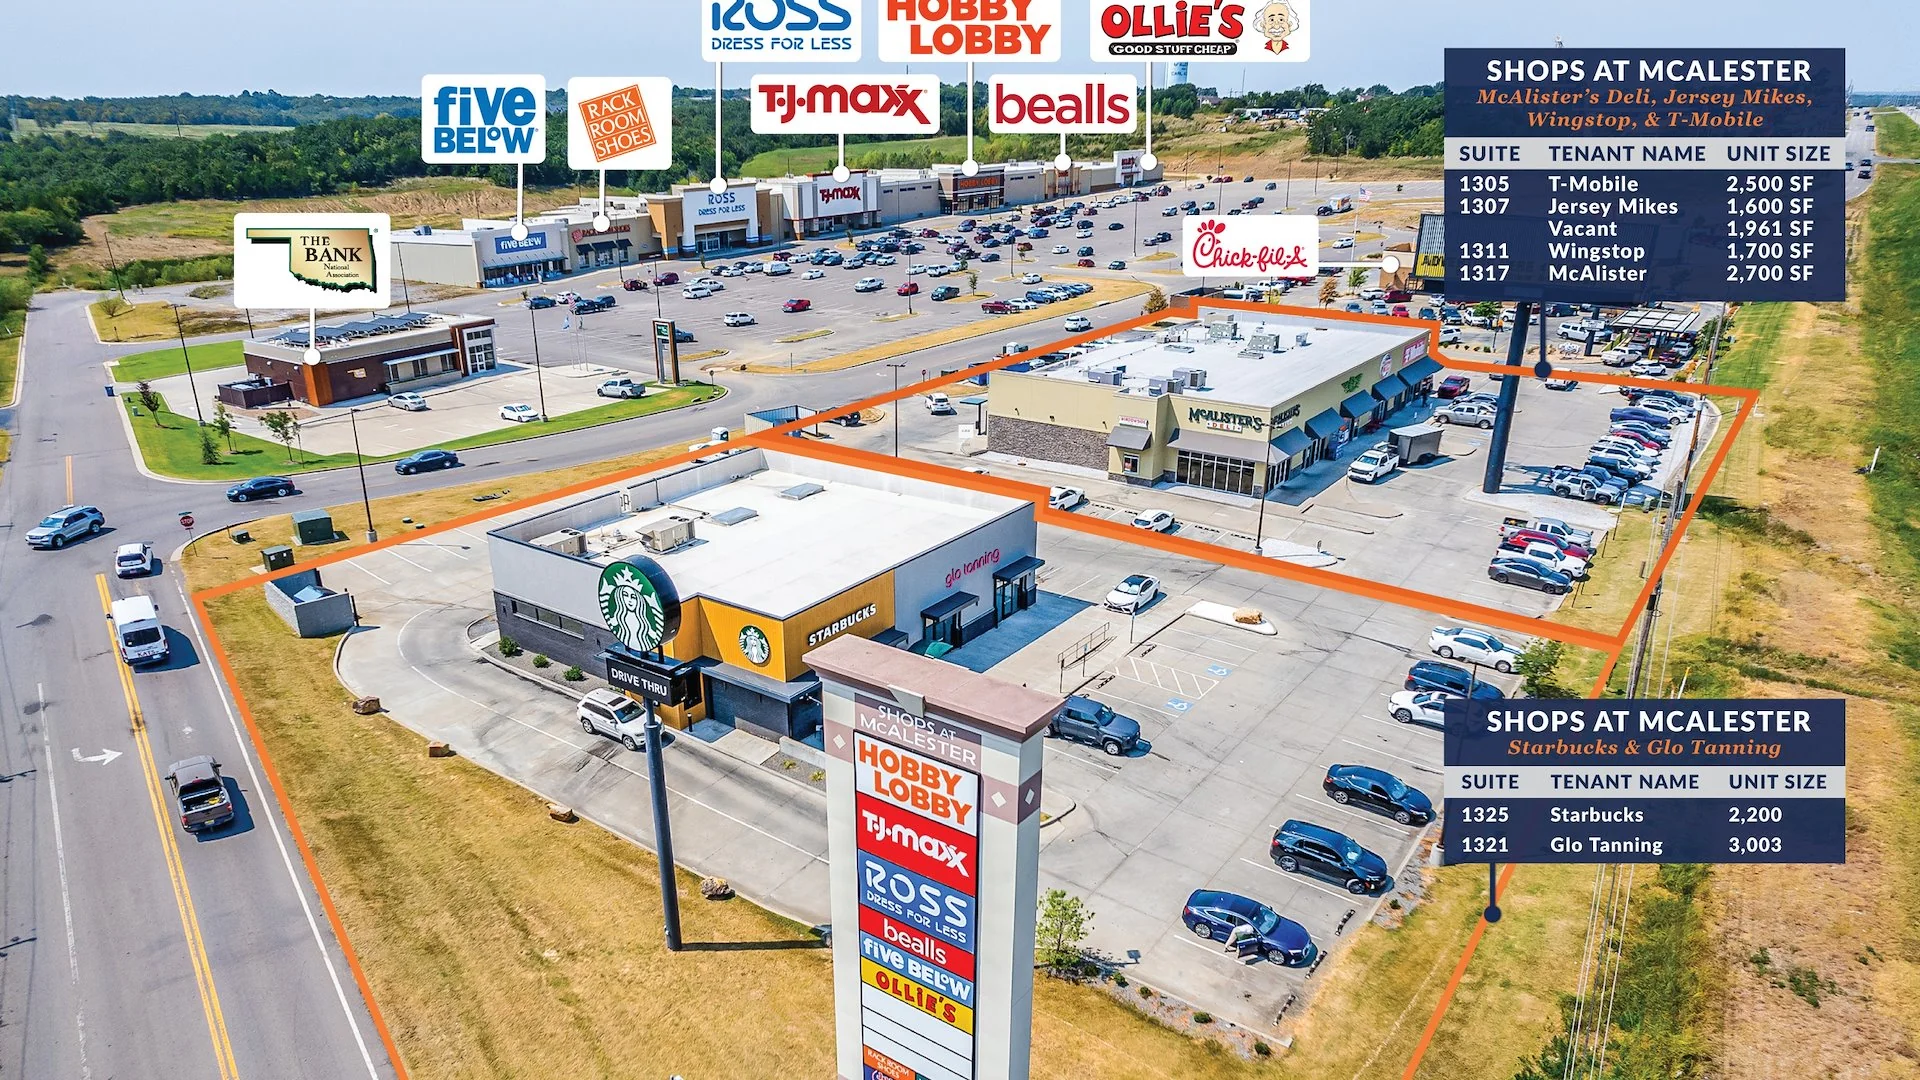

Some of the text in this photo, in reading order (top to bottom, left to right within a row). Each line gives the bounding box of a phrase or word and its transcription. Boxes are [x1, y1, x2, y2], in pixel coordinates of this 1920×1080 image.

[698, 204, 746, 216] DRESS FOR LESS
[708, 192, 736, 205] ROSS
[500, 239, 518, 249] five
[1212, 422, 1236, 432] DELI
[945, 547, 1000, 587] glo tanning
[808, 603, 877, 646] STARBUCKS
[611, 667, 667, 697] DRIVE THRU
[878, 705, 957, 740] SHOPS AT
[858, 739, 962, 796] HOBBY
[874, 770, 973, 826] LOBBY
[865, 860, 967, 927] ROSS
[867, 891, 967, 944] DRESS FOR LESS
[863, 937, 905, 970] five
[883, 918, 947, 965] bealls
[867, 1049, 886, 1064] RACK
[887, 1059, 910, 1076] ROOM
[877, 1061, 900, 1079] SHOES
